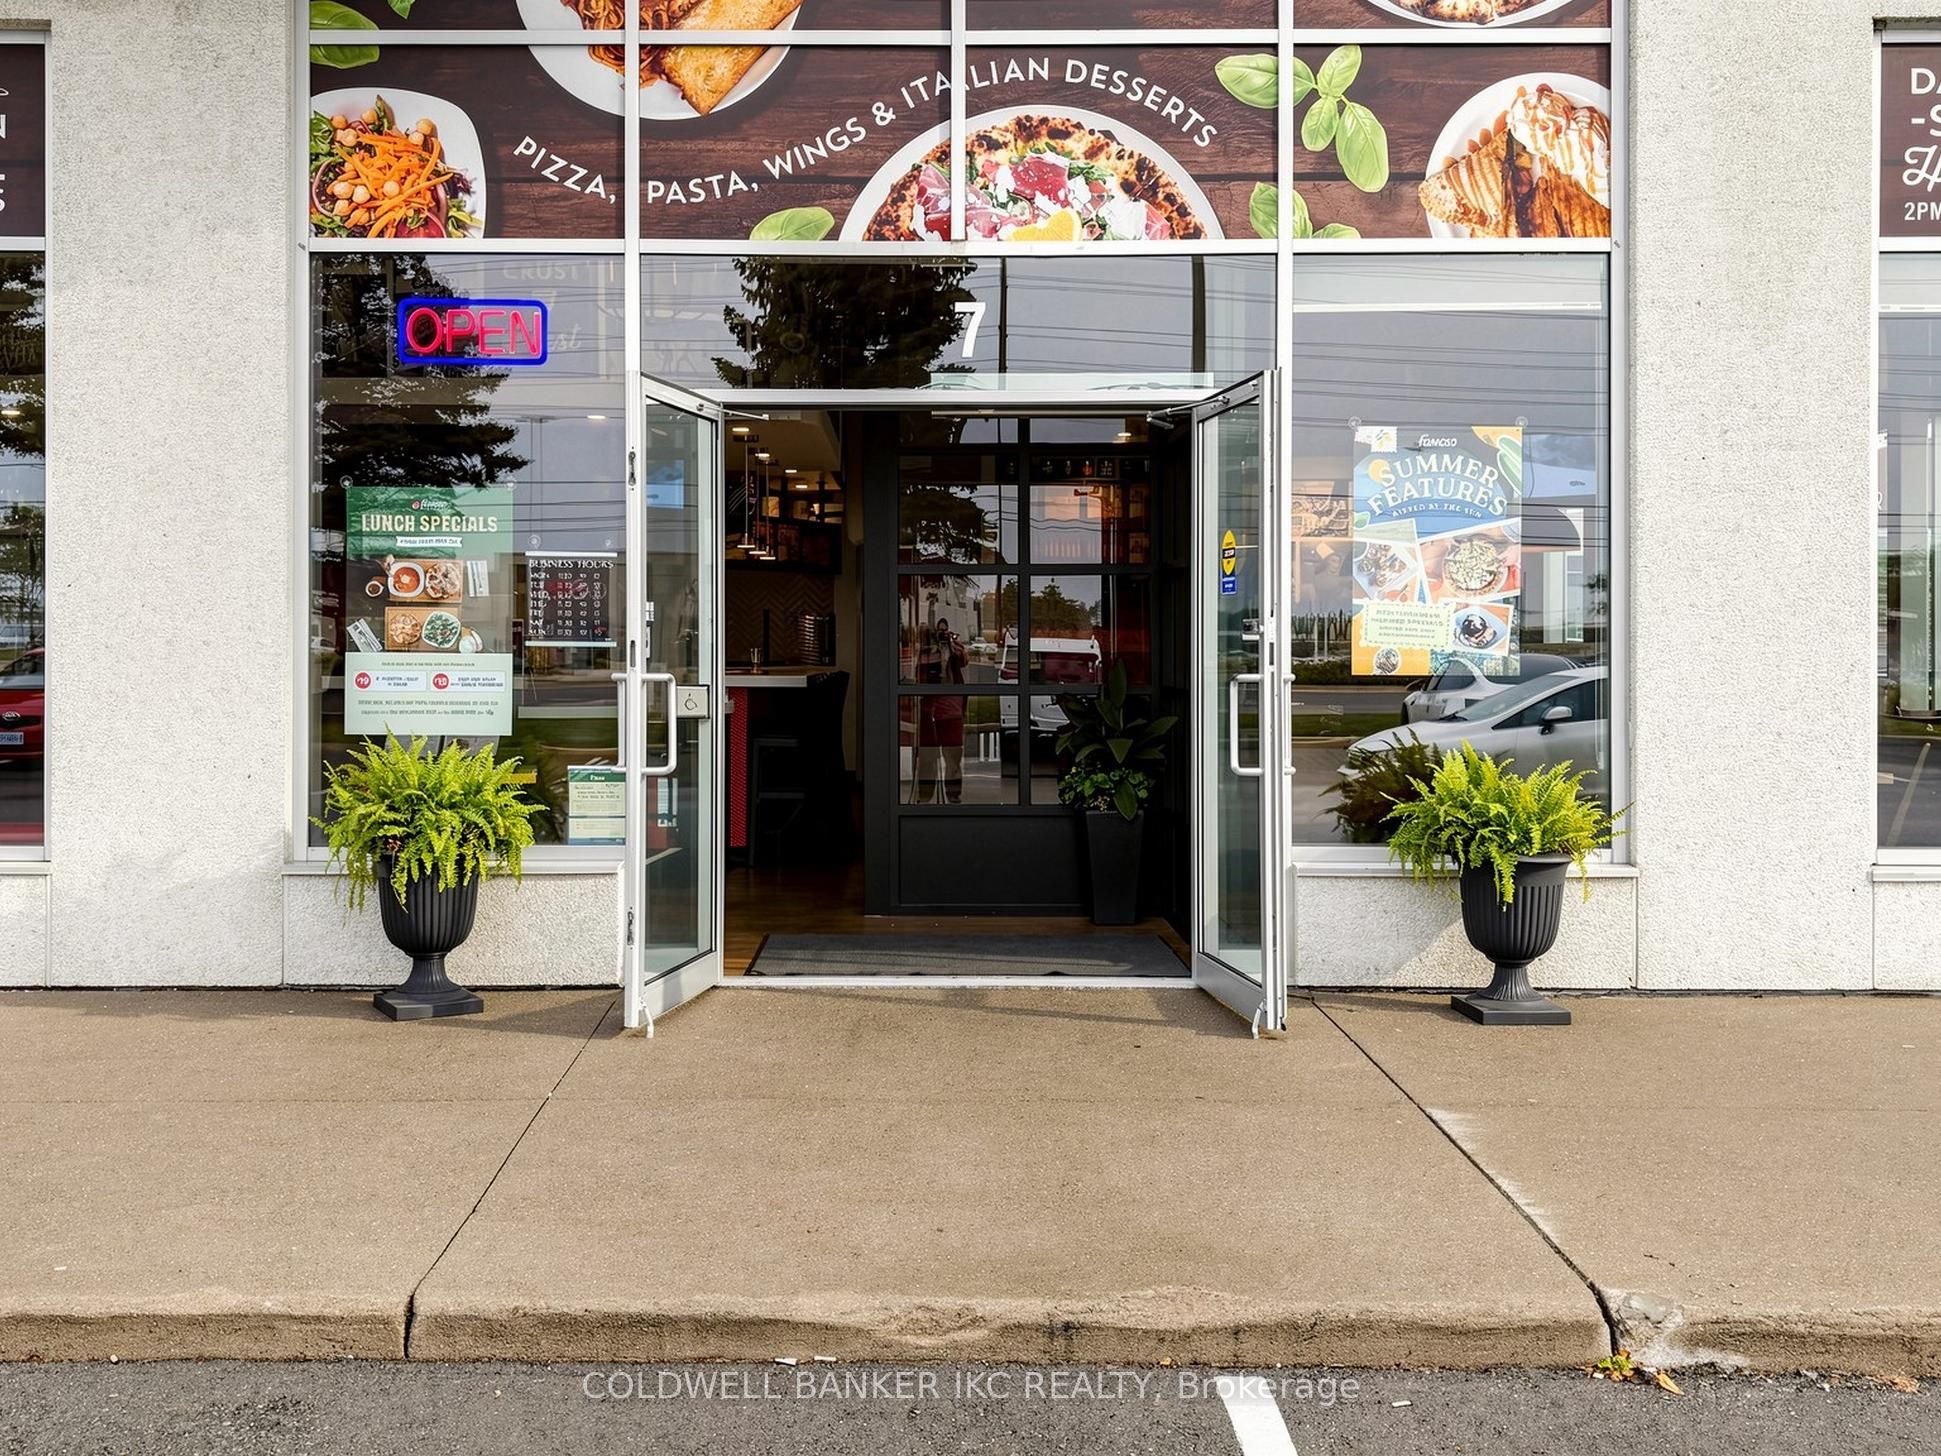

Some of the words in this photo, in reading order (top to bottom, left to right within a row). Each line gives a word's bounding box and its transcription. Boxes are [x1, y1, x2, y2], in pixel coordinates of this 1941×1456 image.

[1911, 67, 1941, 95] D
[513, 135, 616, 205] PIZZA,
[647, 169, 760, 205] PASTA,
[762, 116, 867, 180] WINGS
[872, 100, 897, 127] &
[1064, 59, 1219, 148] DESSERTS
[405, 306, 543, 358] OPEN
[954, 301, 986, 358] 7
[1418, 433, 1457, 448] famoso
[1378, 453, 1499, 489] SUMMER
[1367, 477, 1508, 516] FEATURES
[361, 513, 415, 533] LUNCH
[419, 514, 498, 533] SPECIALS
